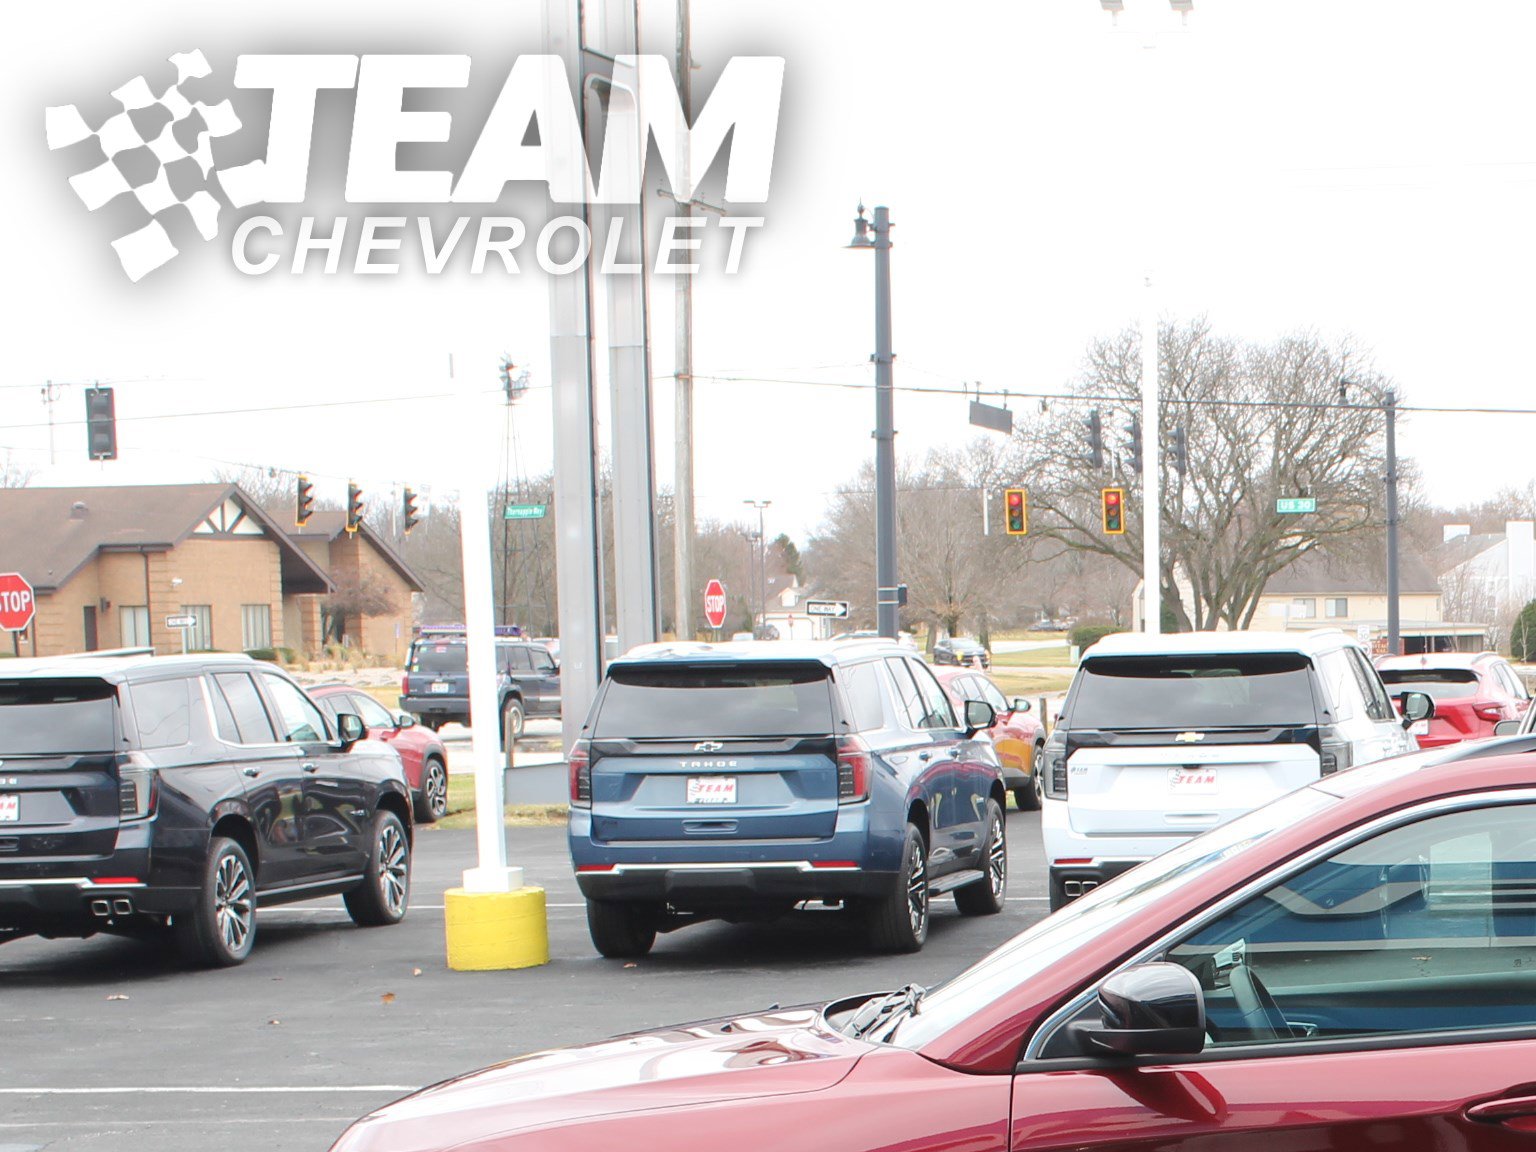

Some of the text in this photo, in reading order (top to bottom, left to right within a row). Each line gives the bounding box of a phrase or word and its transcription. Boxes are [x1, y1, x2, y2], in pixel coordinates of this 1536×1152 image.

[1280, 500, 1295, 510] US
[0, 590, 31, 613] TOP
[706, 595, 725, 613] STOP
[679, 760, 738, 768] TAHOE
[1177, 775, 1216, 784] TEAM
[697, 784, 735, 793] TEAM
